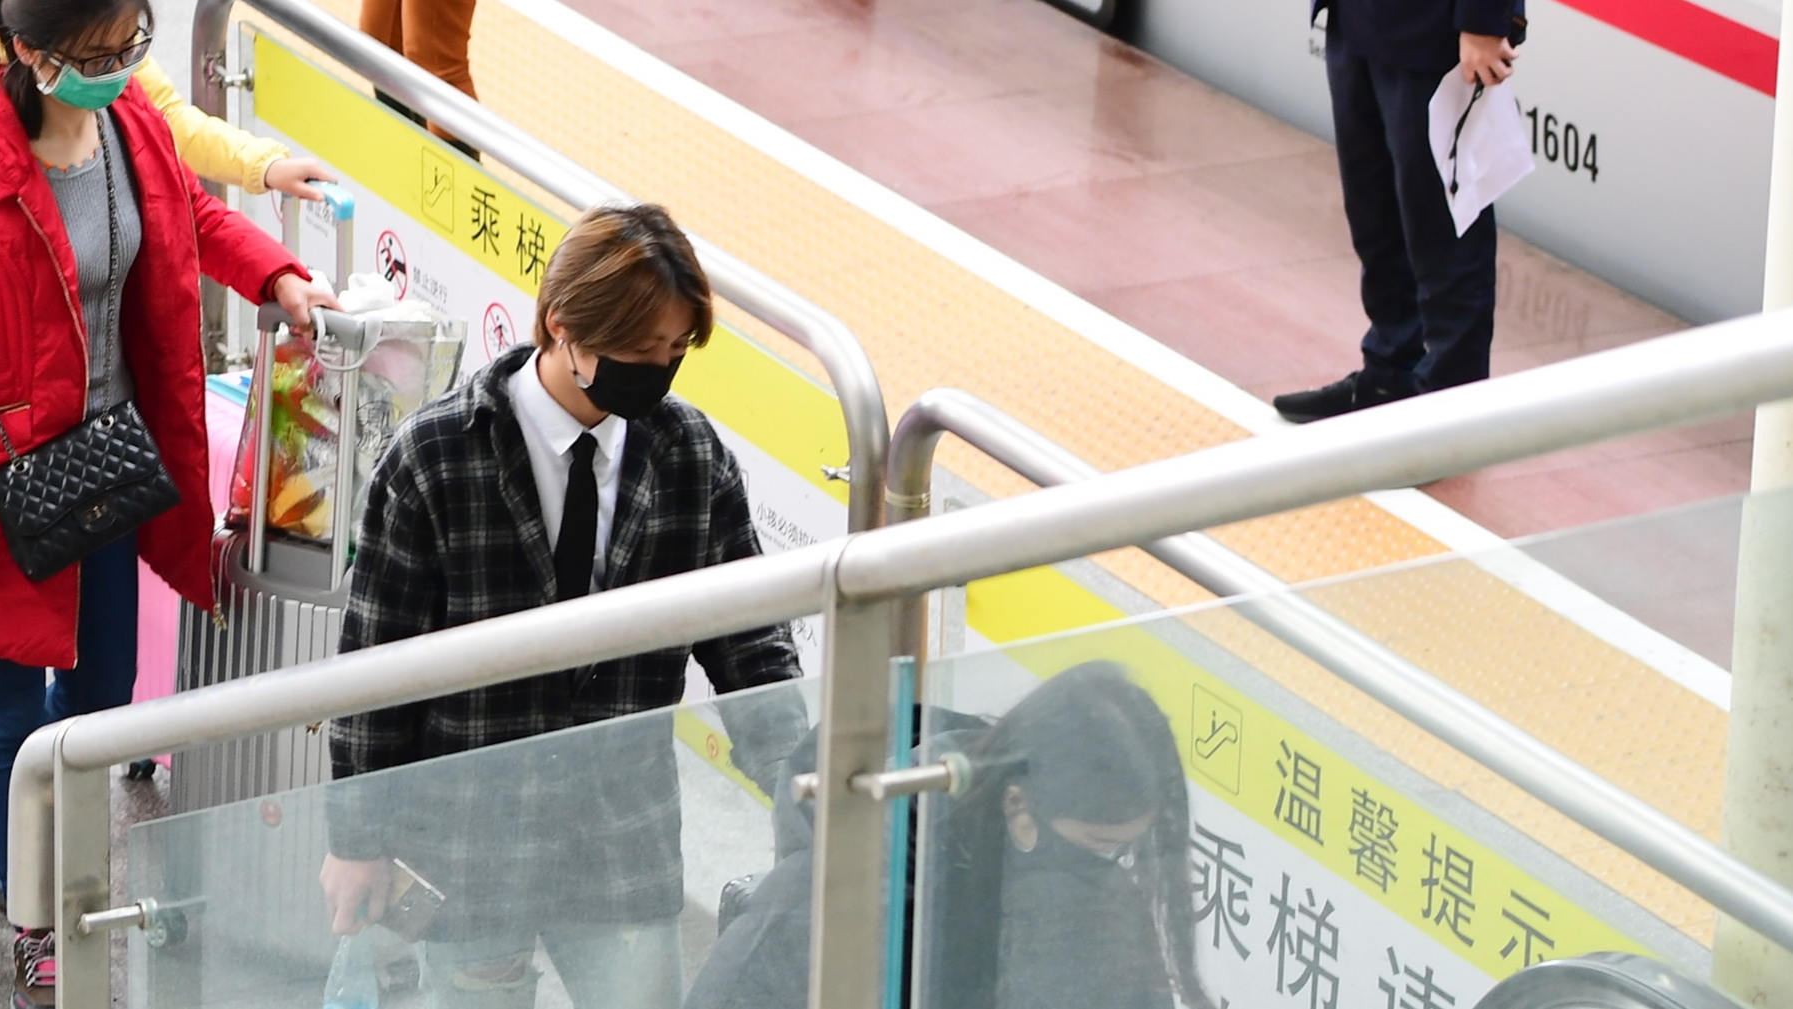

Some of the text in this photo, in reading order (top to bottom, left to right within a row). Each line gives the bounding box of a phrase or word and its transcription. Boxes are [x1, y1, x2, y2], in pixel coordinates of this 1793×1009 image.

[1514, 97, 1599, 183] 1604
[471, 186, 546, 286] 乘梯
[1273, 739, 1556, 969] 温馨提示
